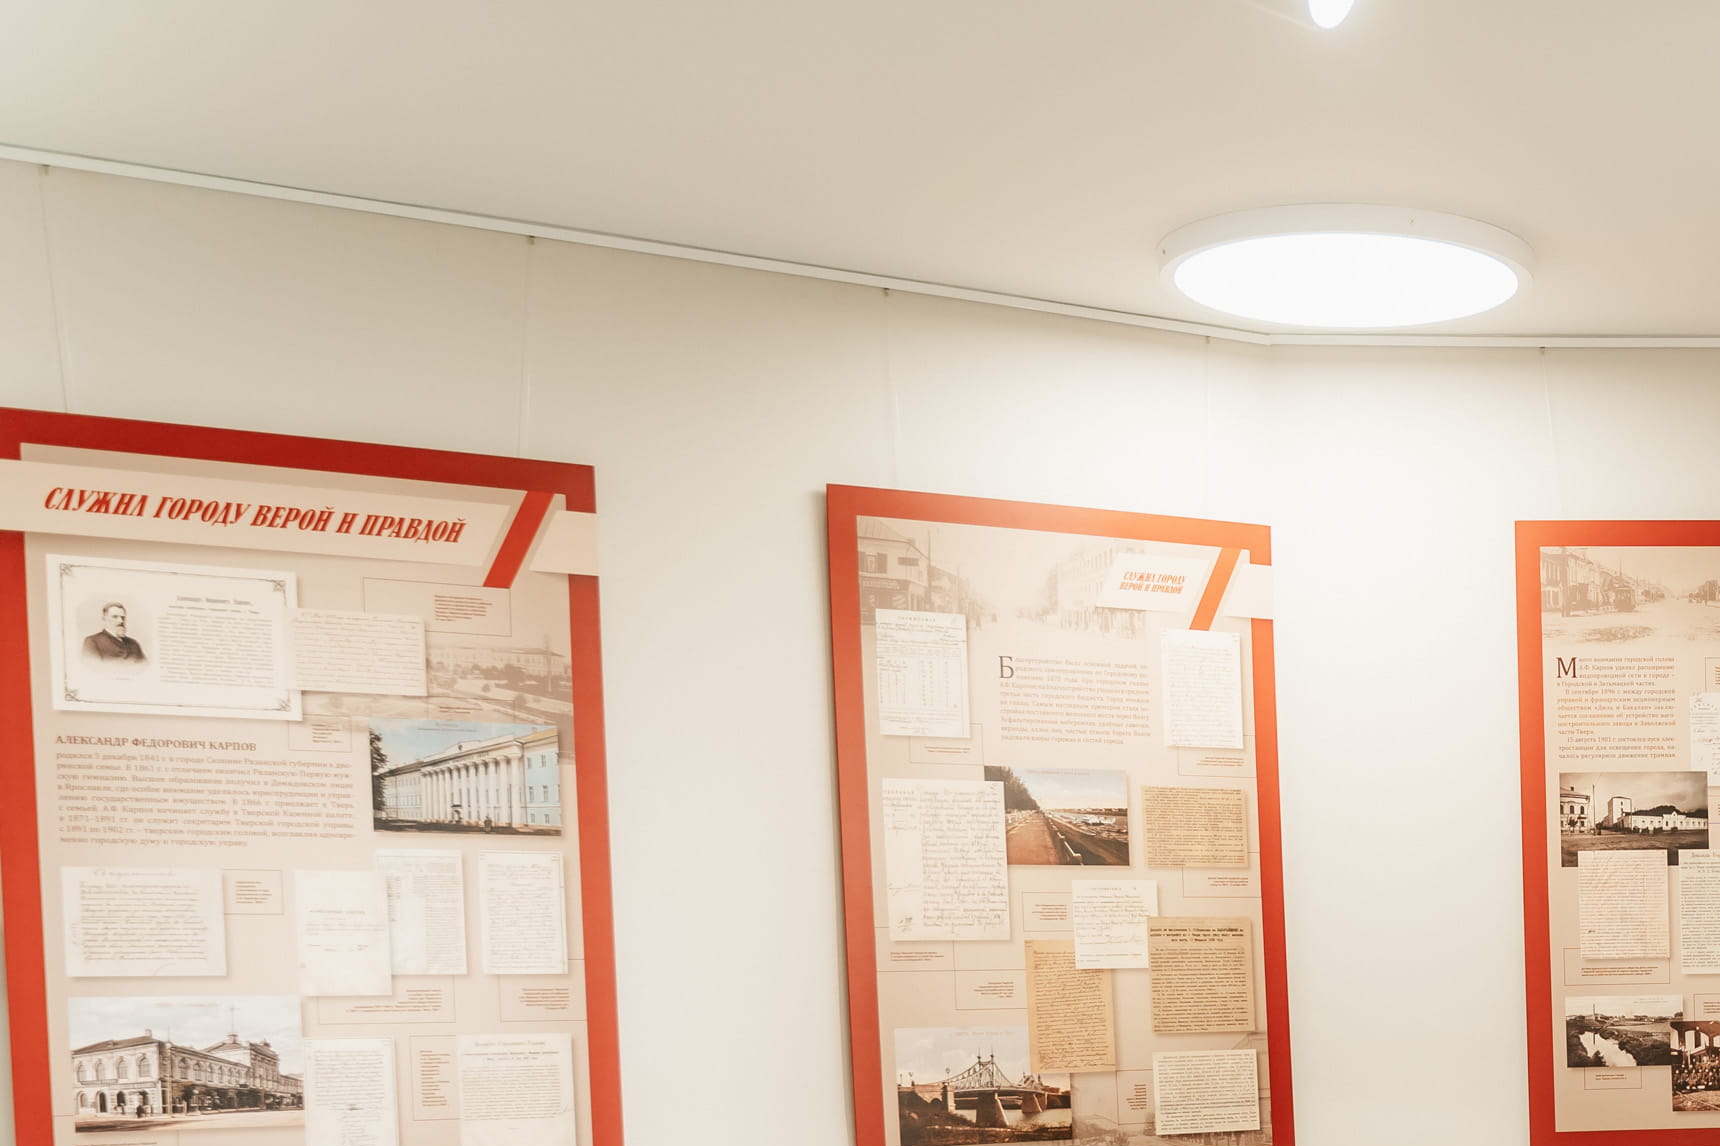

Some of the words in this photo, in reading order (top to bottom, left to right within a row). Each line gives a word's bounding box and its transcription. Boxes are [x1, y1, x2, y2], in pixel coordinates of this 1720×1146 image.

[44, 487, 149, 517] СЛУЖИЛ
[153, 496, 251, 527] ГОРОДУ
[250, 504, 335, 532] ВЕРОЙ
[336, 512, 359, 534] И
[358, 514, 467, 544] ПРАВДОЙ
[55, 735, 129, 747] АЛЕКСАНДР
[131, 737, 206, 749] ФЕДОРОВИЧ
[209, 741, 257, 751] КАРПОВ
